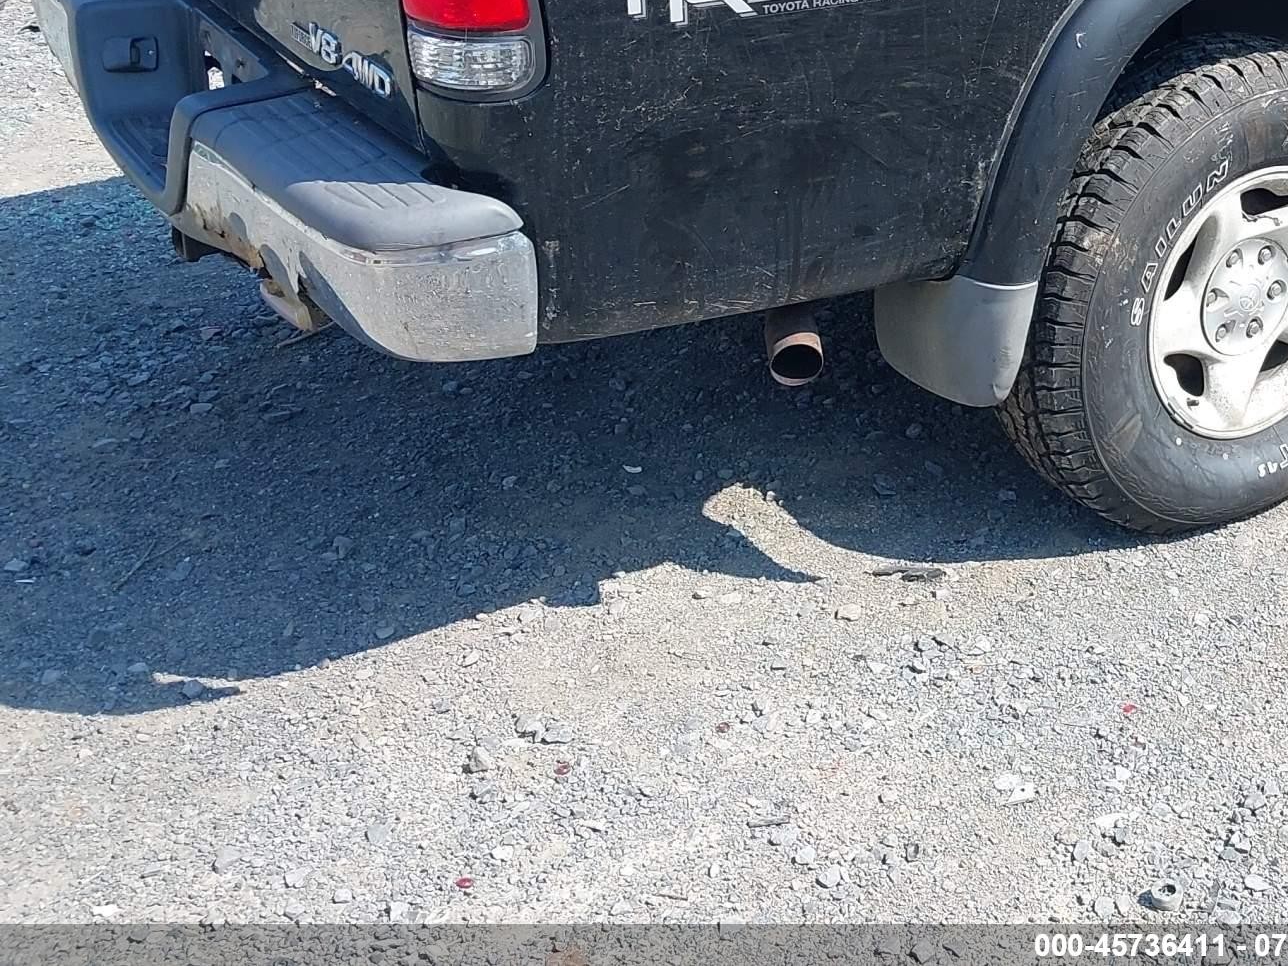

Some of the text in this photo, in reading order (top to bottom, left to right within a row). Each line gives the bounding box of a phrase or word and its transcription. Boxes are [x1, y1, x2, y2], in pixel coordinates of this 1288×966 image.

[763, 0, 809, 15] TOYOTA
[308, 22, 338, 65] V8
[342, 51, 391, 99] 4WD
[1130, 159, 1229, 326] SAILUN
